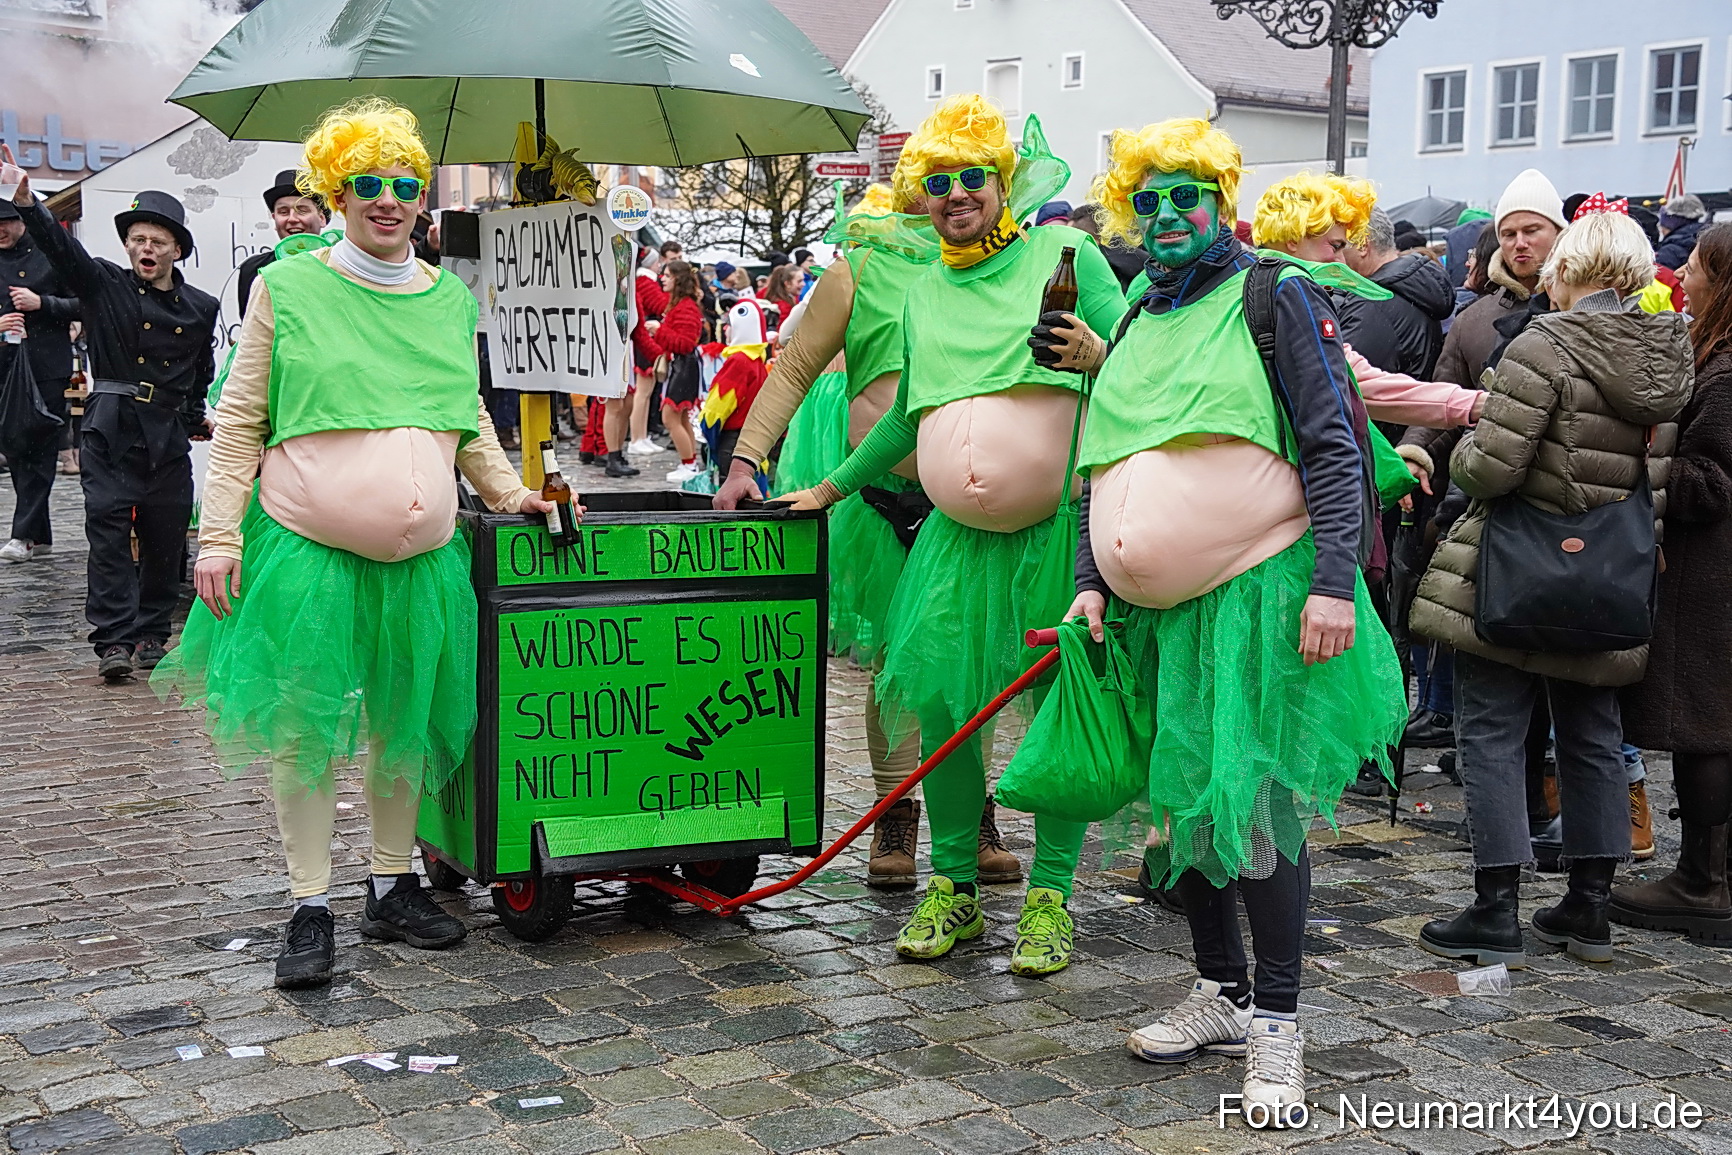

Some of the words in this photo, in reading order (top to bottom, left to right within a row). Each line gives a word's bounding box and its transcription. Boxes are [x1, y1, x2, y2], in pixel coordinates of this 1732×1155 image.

[0, 109, 142, 171] tte
[499, 305, 607, 378] BIERFEEN
[510, 530, 609, 576] OHNE
[649, 526, 786, 574] BAUERN
[510, 612, 644, 669] WÜRDE
[675, 616, 720, 665] ES
[741, 611, 803, 664] UNS
[514, 682, 667, 740] SCHÖNE
[664, 667, 801, 762] WESEN
[515, 749, 623, 801] NICHT
[638, 767, 761, 820] GEBEN
